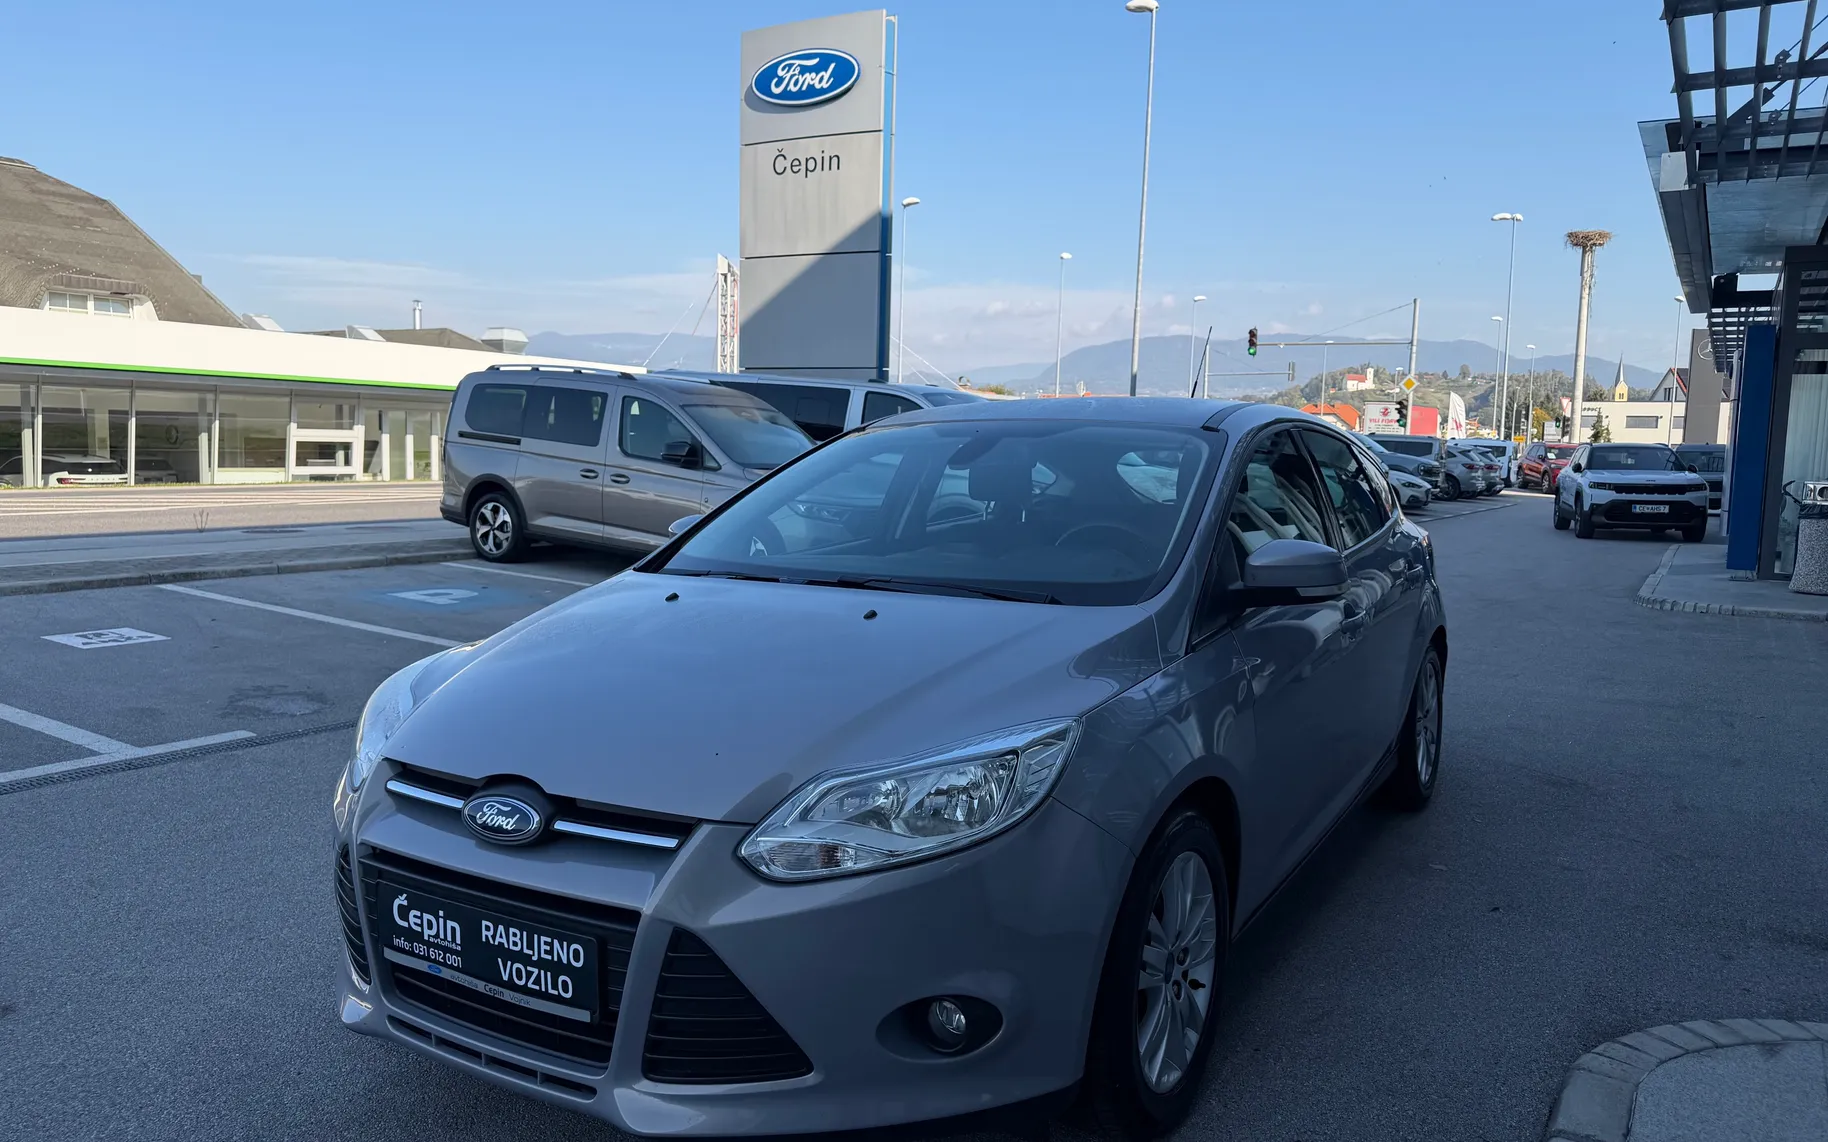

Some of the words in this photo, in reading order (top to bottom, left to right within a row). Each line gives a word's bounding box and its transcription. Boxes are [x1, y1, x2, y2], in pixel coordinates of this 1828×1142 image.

[771, 57, 836, 95] Ford
[772, 148, 841, 179] Čepin
[476, 801, 521, 831] Ford
[392, 893, 461, 945] Čepin
[393, 934, 412, 951] info:
[413, 942, 428, 957] 031
[430, 946, 444, 963] 612
[446, 953, 462, 968] 001
[481, 919, 585, 968] RABLJENO
[497, 957, 573, 999] VOZILO
